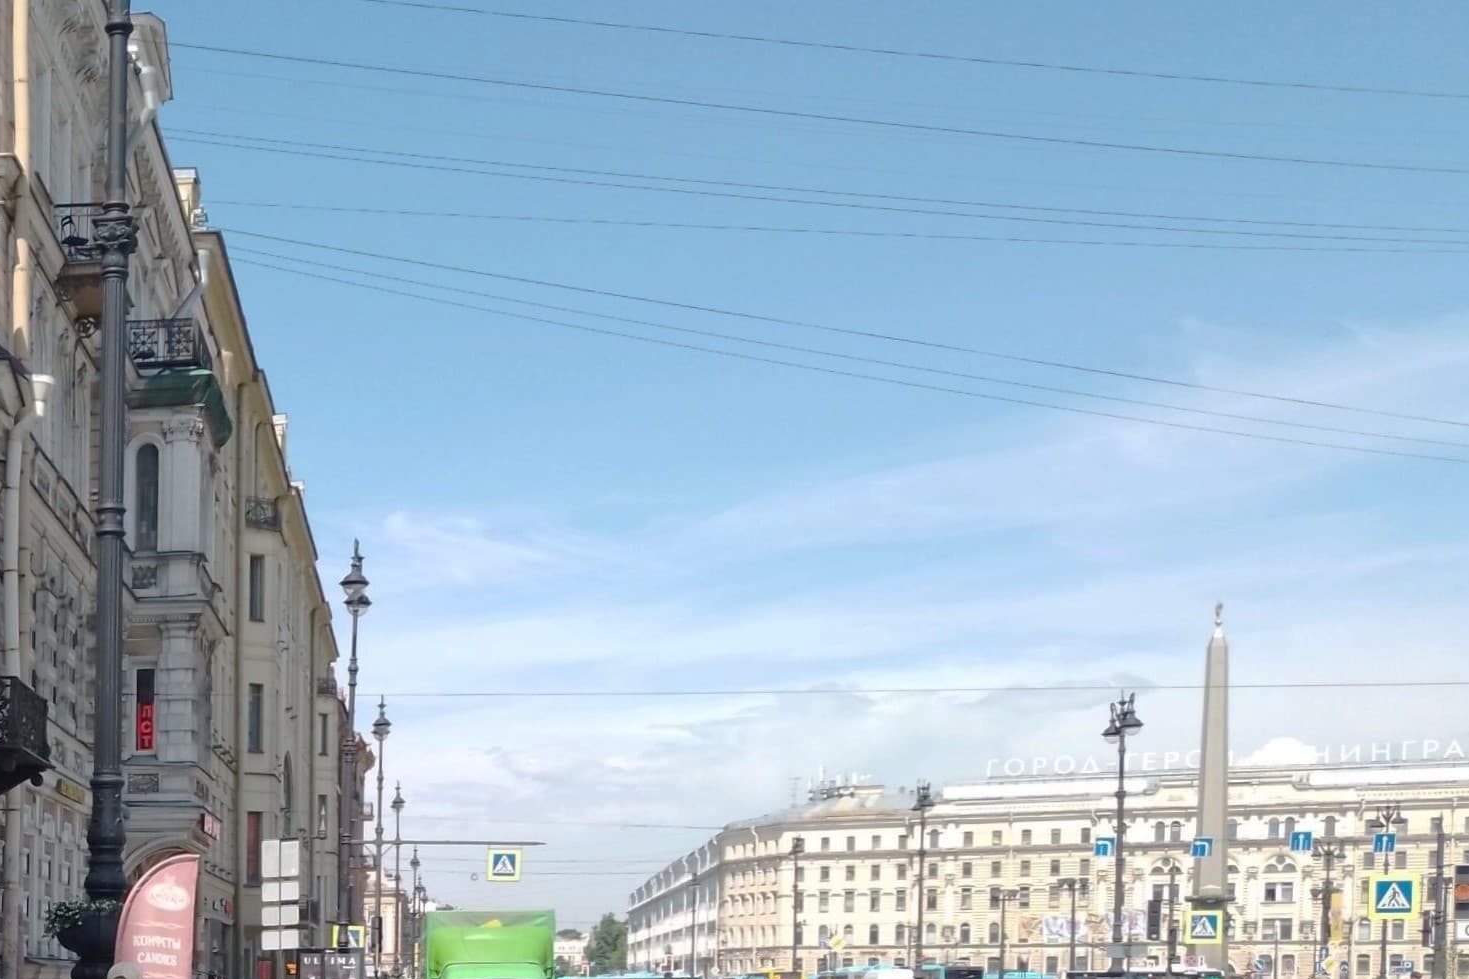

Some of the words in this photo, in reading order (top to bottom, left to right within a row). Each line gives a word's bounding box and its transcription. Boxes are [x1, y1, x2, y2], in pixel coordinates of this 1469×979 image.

[985, 750, 1234, 777] ГОРОД-ГЕРО
[1262, 738, 1466, 767] НИНГРА
[304, 956, 356, 965] ULIMA
